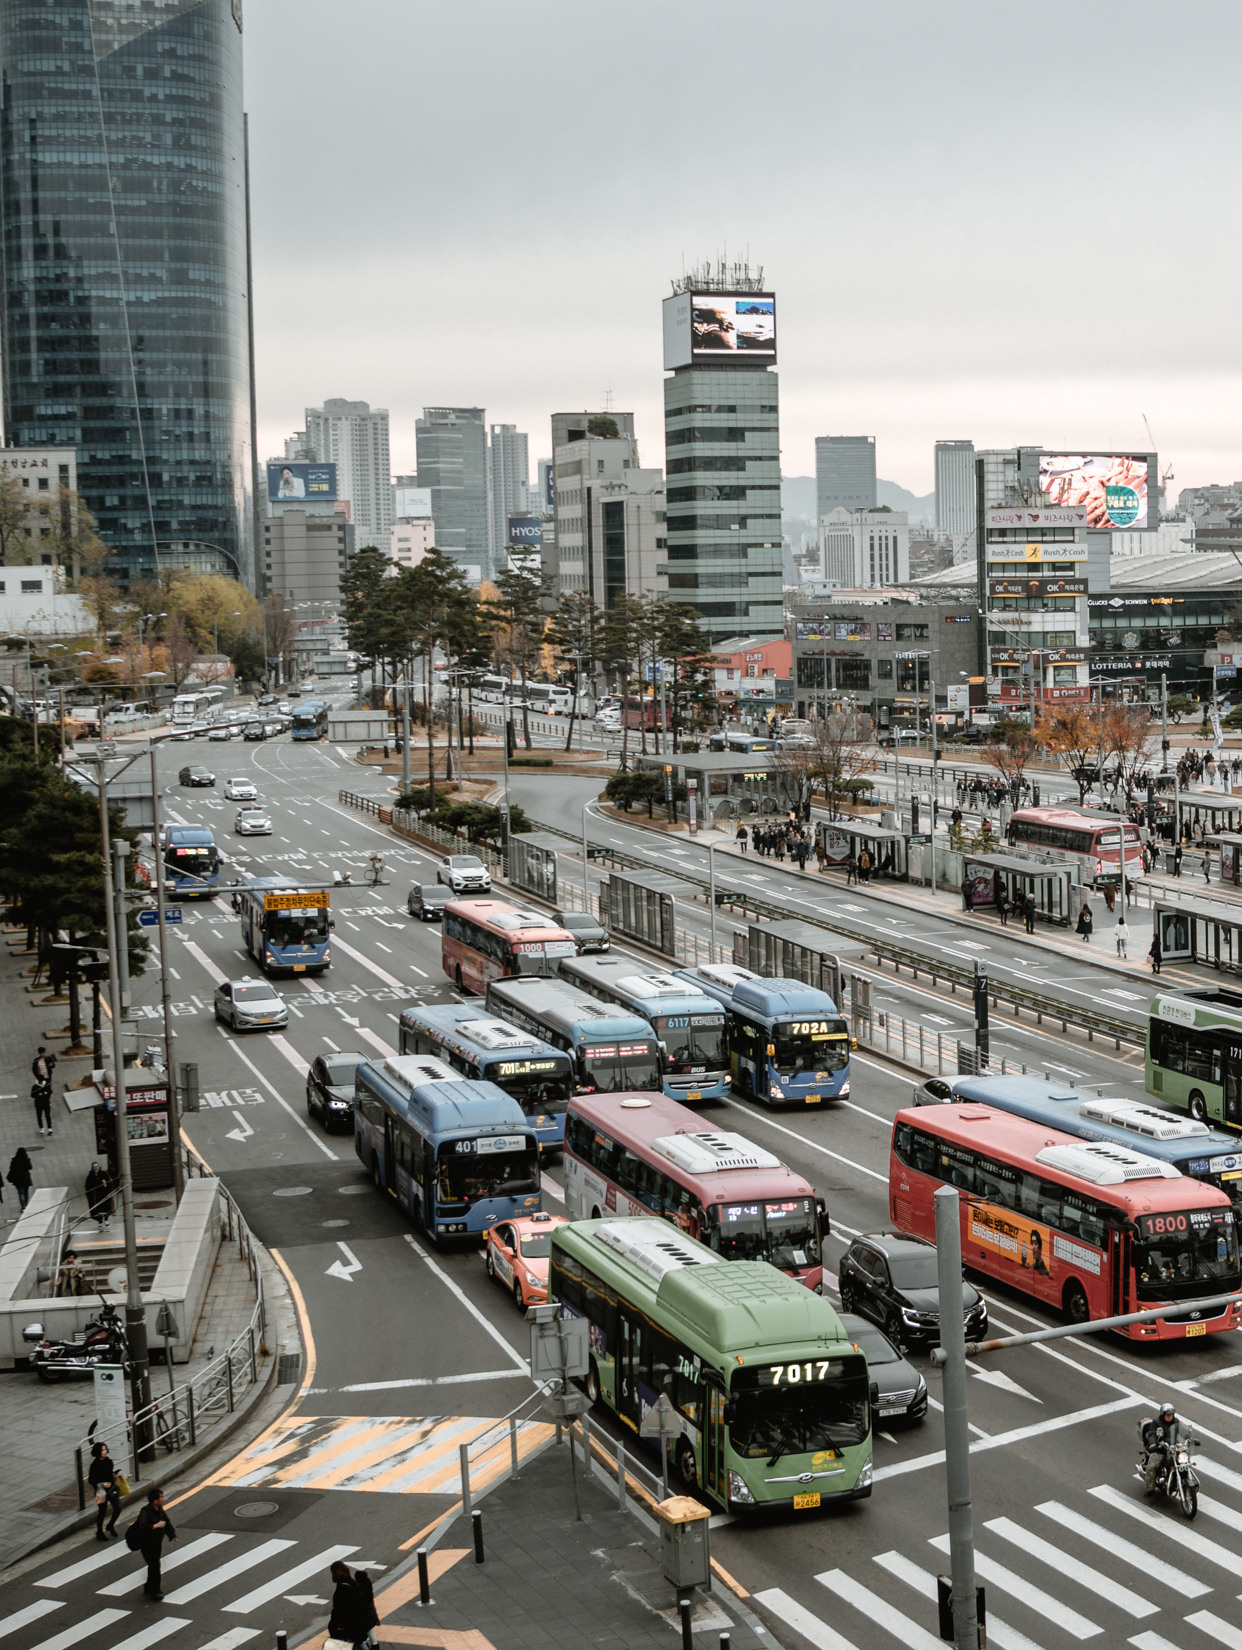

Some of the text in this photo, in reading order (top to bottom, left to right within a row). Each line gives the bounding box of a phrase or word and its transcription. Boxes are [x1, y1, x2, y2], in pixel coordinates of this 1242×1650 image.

[512, 526, 542, 536] HYOS
[1043, 548, 1086, 557] Rush Cash
[1145, 661, 1170, 669] 롯데리아
[520, 943, 543, 953] 1000
[668, 1016, 689, 1028] 6117
[792, 1022, 828, 1034] 702A
[500, 1062, 515, 1075] 701
[456, 1141, 477, 1153] 401
[1147, 1215, 1187, 1234] 1800
[679, 1355, 700, 1384] 7017
[770, 1361, 829, 1385] 7017
